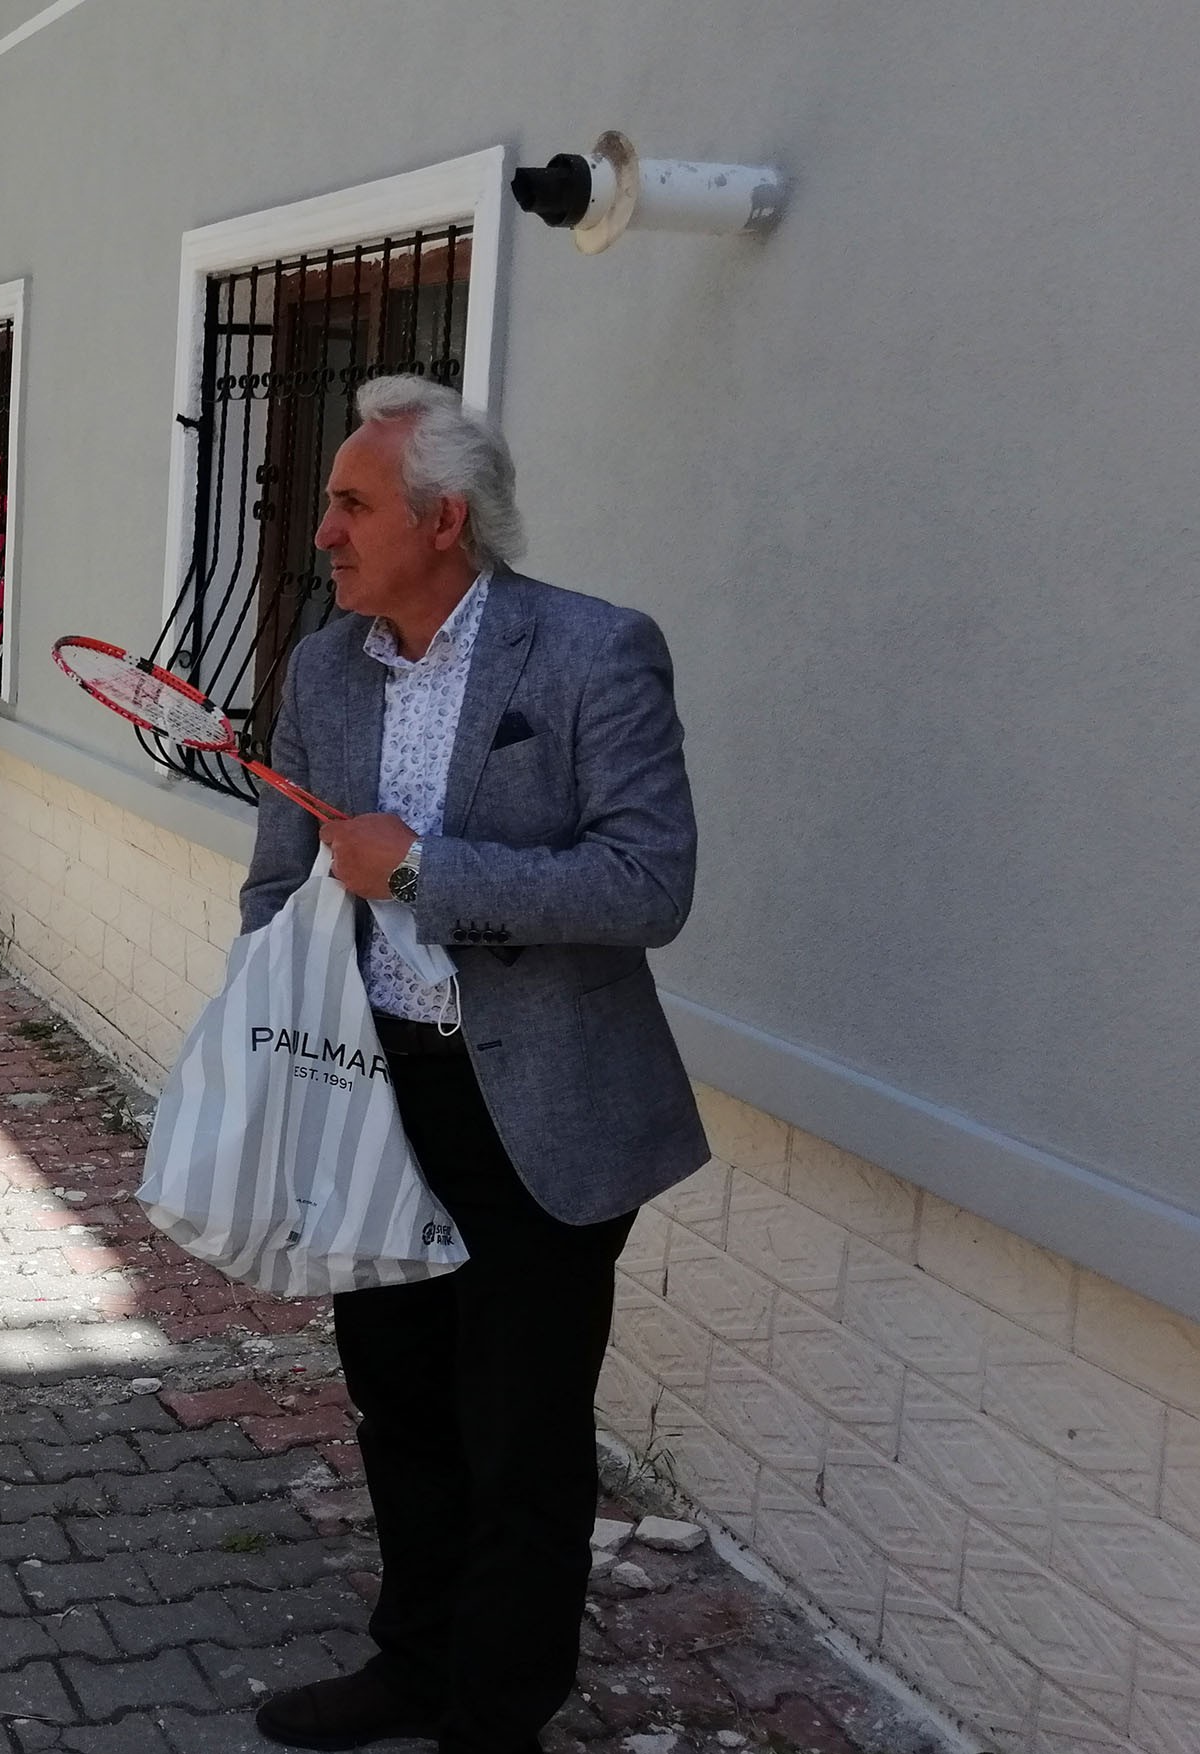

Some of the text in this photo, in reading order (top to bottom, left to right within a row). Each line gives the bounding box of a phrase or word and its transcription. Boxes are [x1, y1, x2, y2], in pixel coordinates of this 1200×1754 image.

[251, 1027, 393, 1086] PAULMAR
[294, 1066, 353, 1092] EST. 1991
